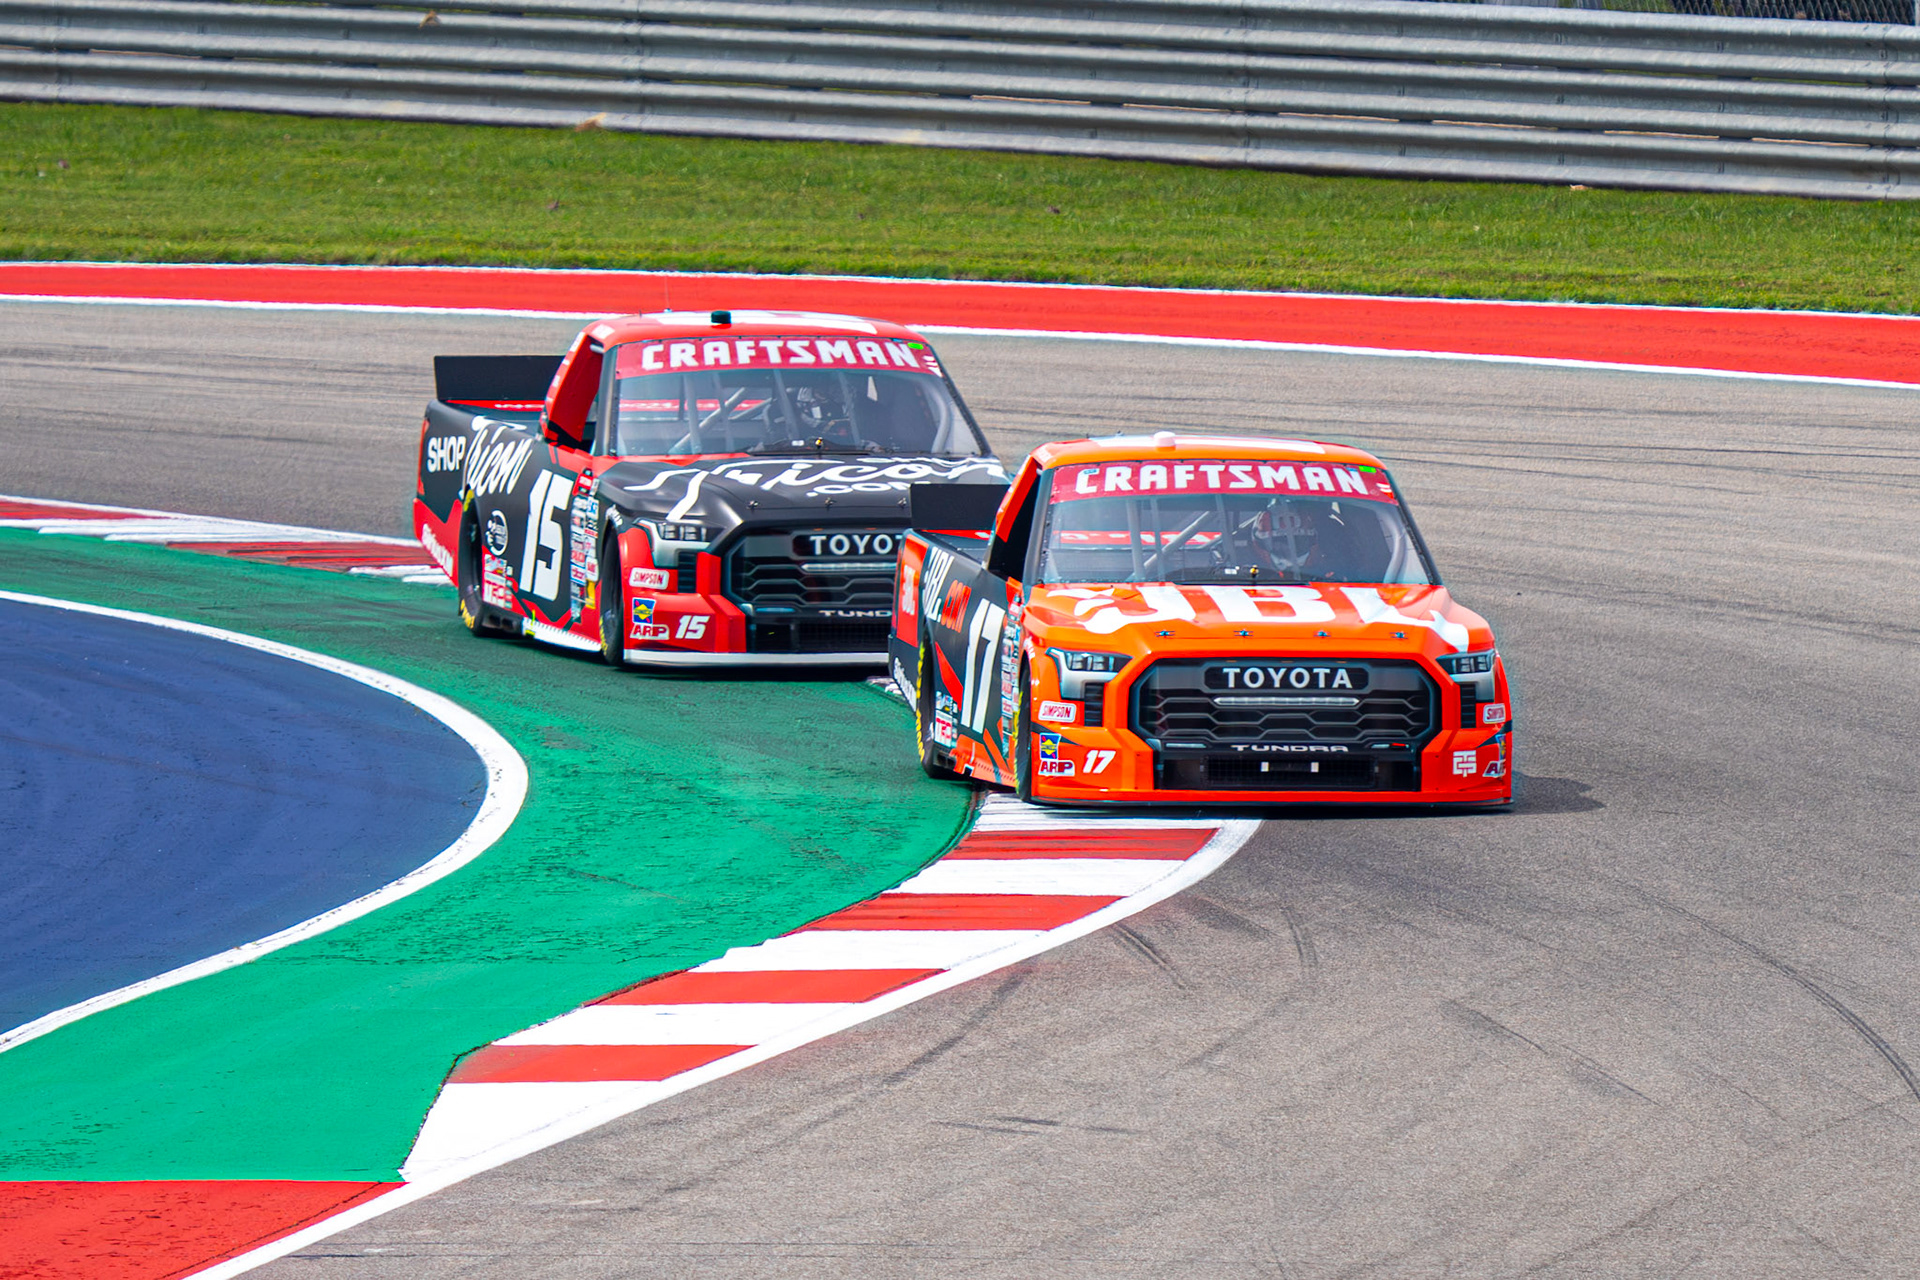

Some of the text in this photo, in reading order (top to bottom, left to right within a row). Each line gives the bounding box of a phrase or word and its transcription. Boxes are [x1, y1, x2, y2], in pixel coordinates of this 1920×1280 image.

[641, 340, 919, 371] CRAFTSMAN
[427, 415, 534, 499] SHOP Tricon
[624, 458, 1012, 521] Tricon
[1074, 463, 1370, 495] CRAFTSMAN
[519, 468, 574, 602] 15
[633, 571, 665, 586] SIMPSON
[633, 615, 710, 640] ARP 15
[1048, 585, 1470, 653] JBL
[960, 598, 1005, 734] 17
[1222, 667, 1354, 689] TOYOTA
[1042, 704, 1072, 718] SIMPSON
[1041, 749, 1117, 774] ARP 17
[1231, 744, 1349, 752] TUNDRA
